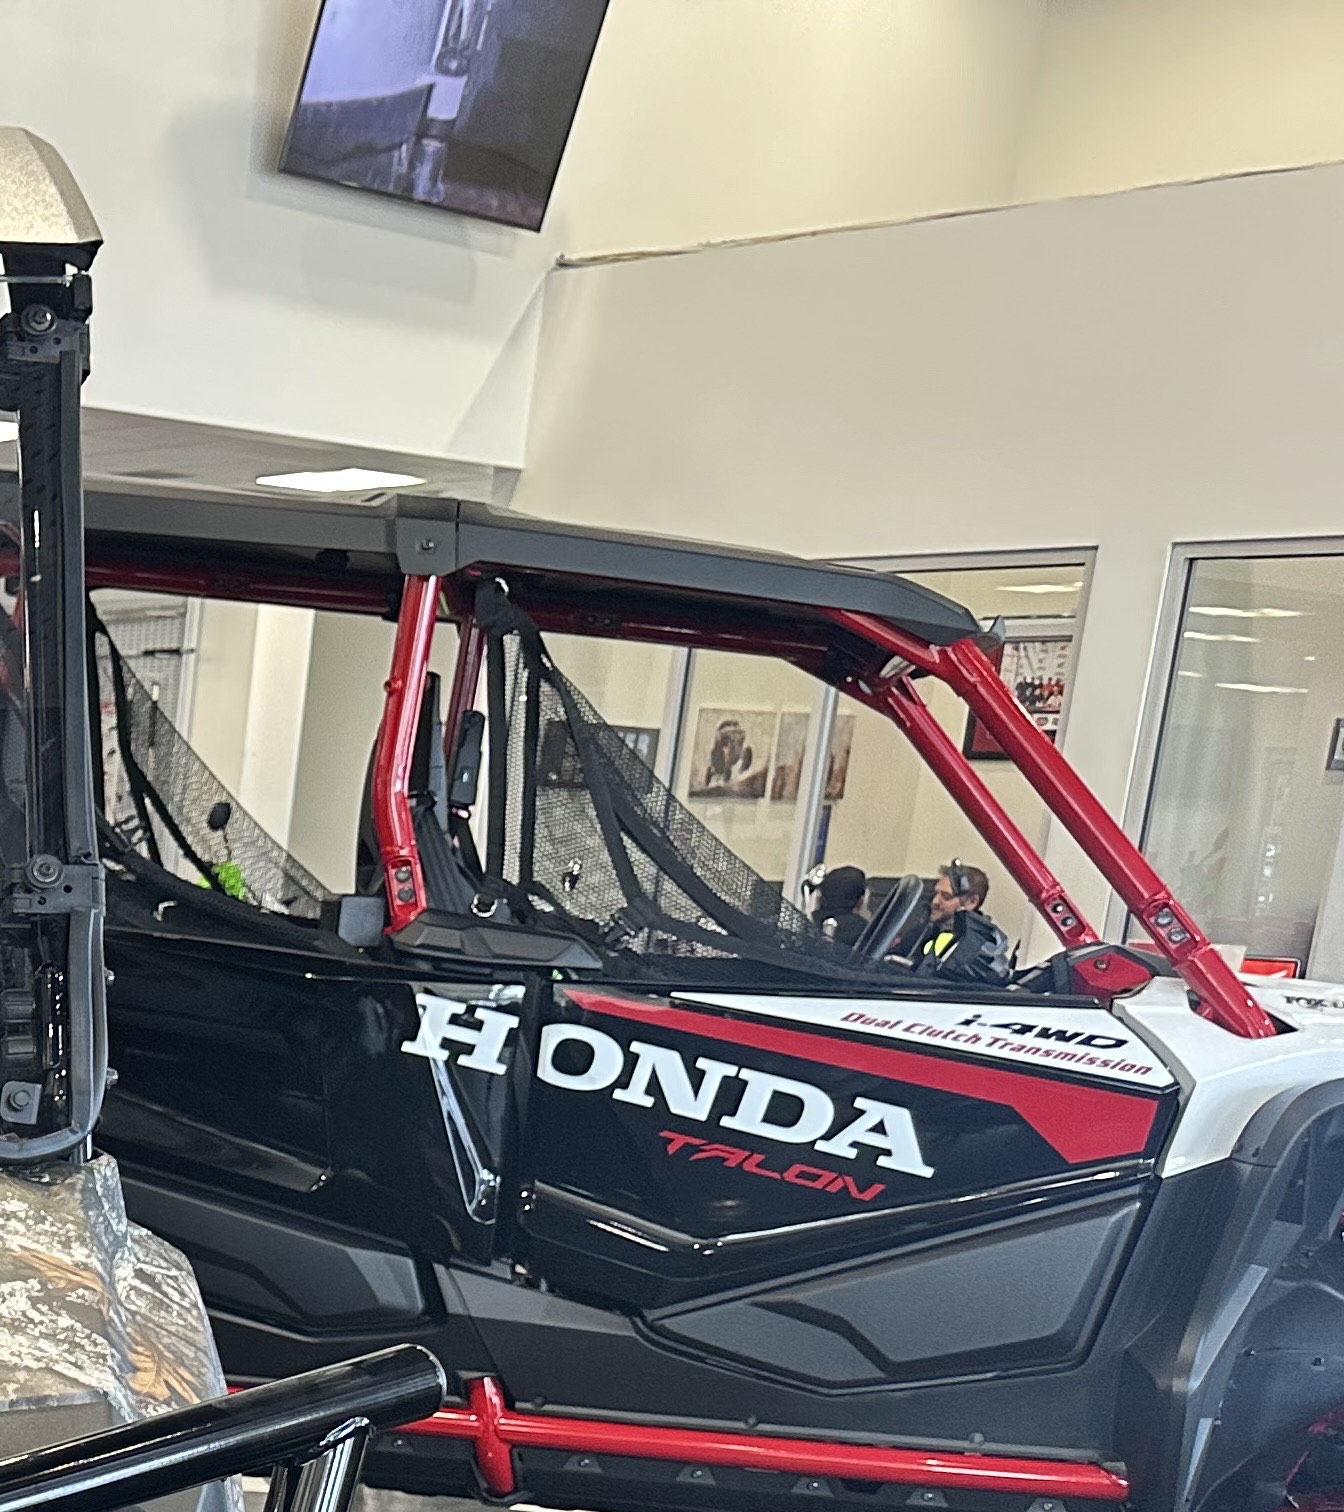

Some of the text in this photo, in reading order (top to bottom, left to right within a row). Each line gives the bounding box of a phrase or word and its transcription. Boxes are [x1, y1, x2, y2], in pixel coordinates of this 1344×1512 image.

[840, 1011, 1153, 1076] Dual Clutch Transmission
[955, 1014, 1128, 1050] i-4WD
[401, 992, 934, 1178] HONDA
[658, 1129, 886, 1201] TALON
